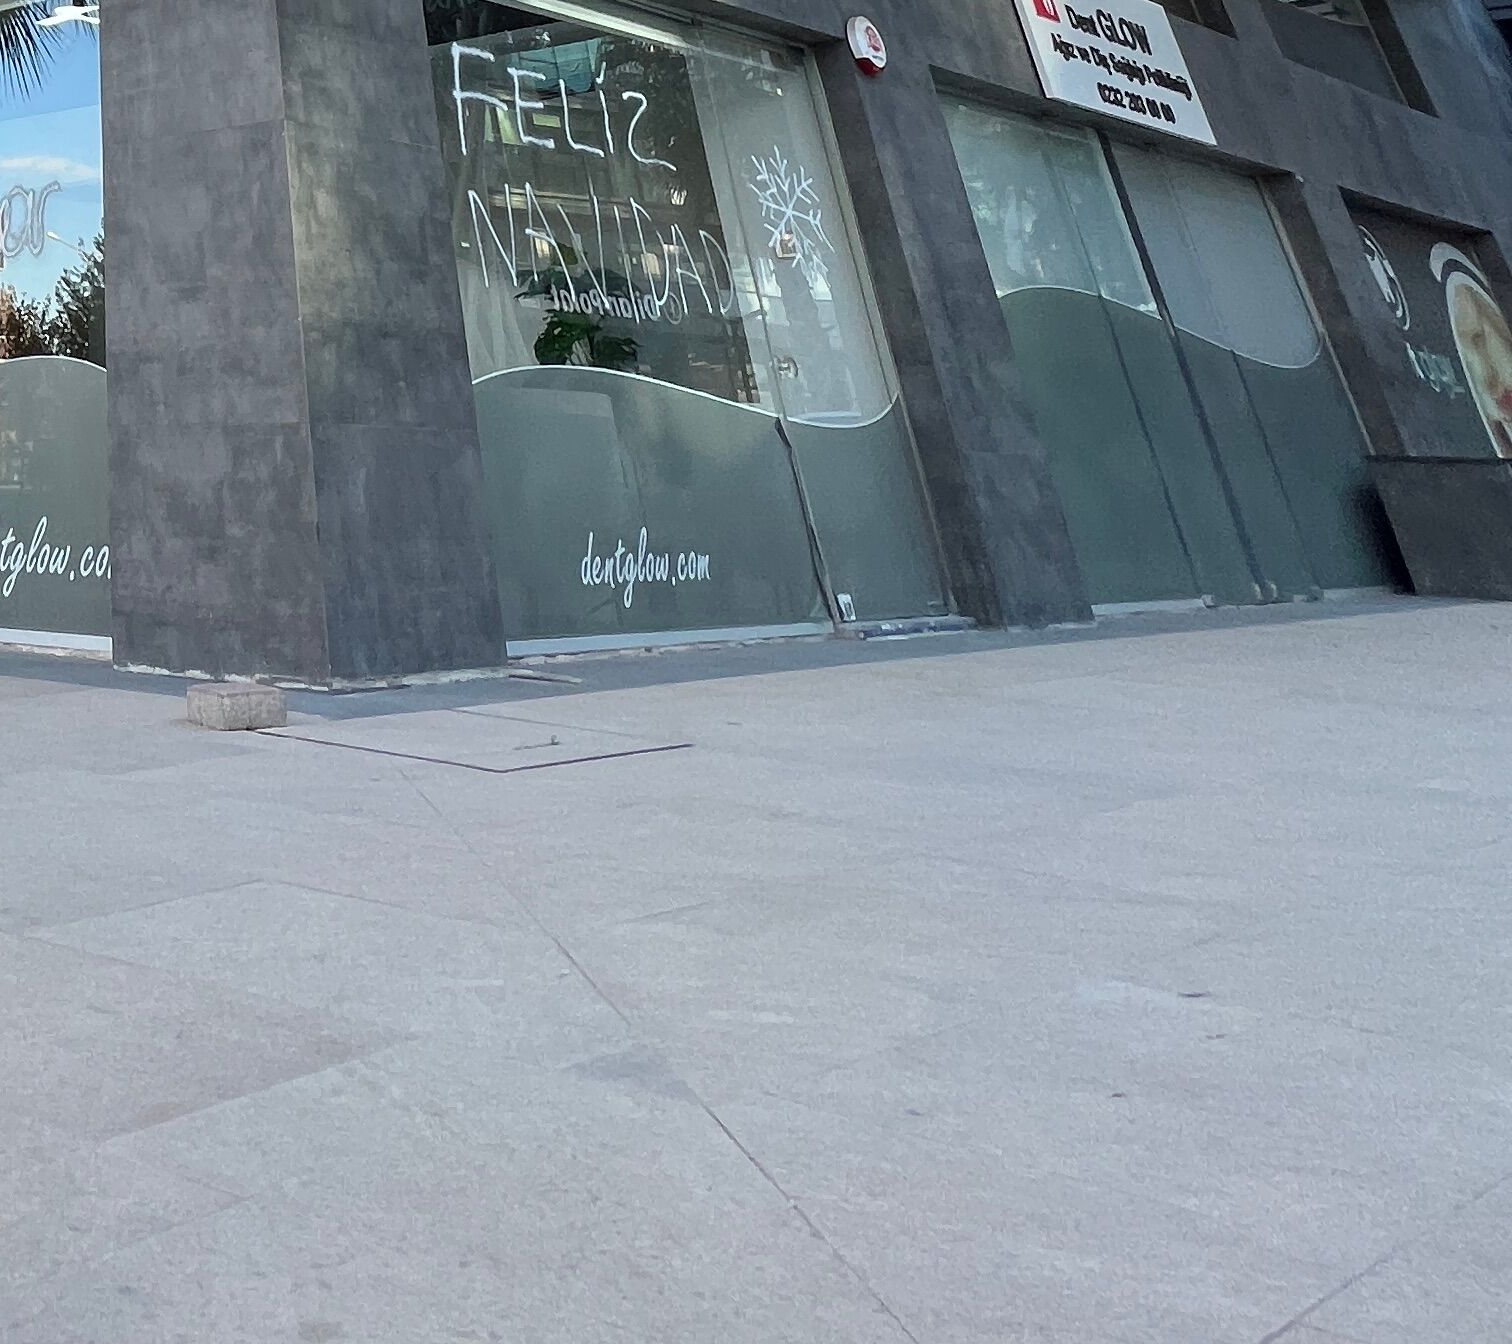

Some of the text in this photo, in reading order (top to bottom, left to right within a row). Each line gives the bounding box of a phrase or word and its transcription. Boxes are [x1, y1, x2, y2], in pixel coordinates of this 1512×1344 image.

[1096, 9, 1152, 56] GLOW
[468, 178, 736, 323] NAVIDAD
[581, 526, 711, 608] dentglow.com
